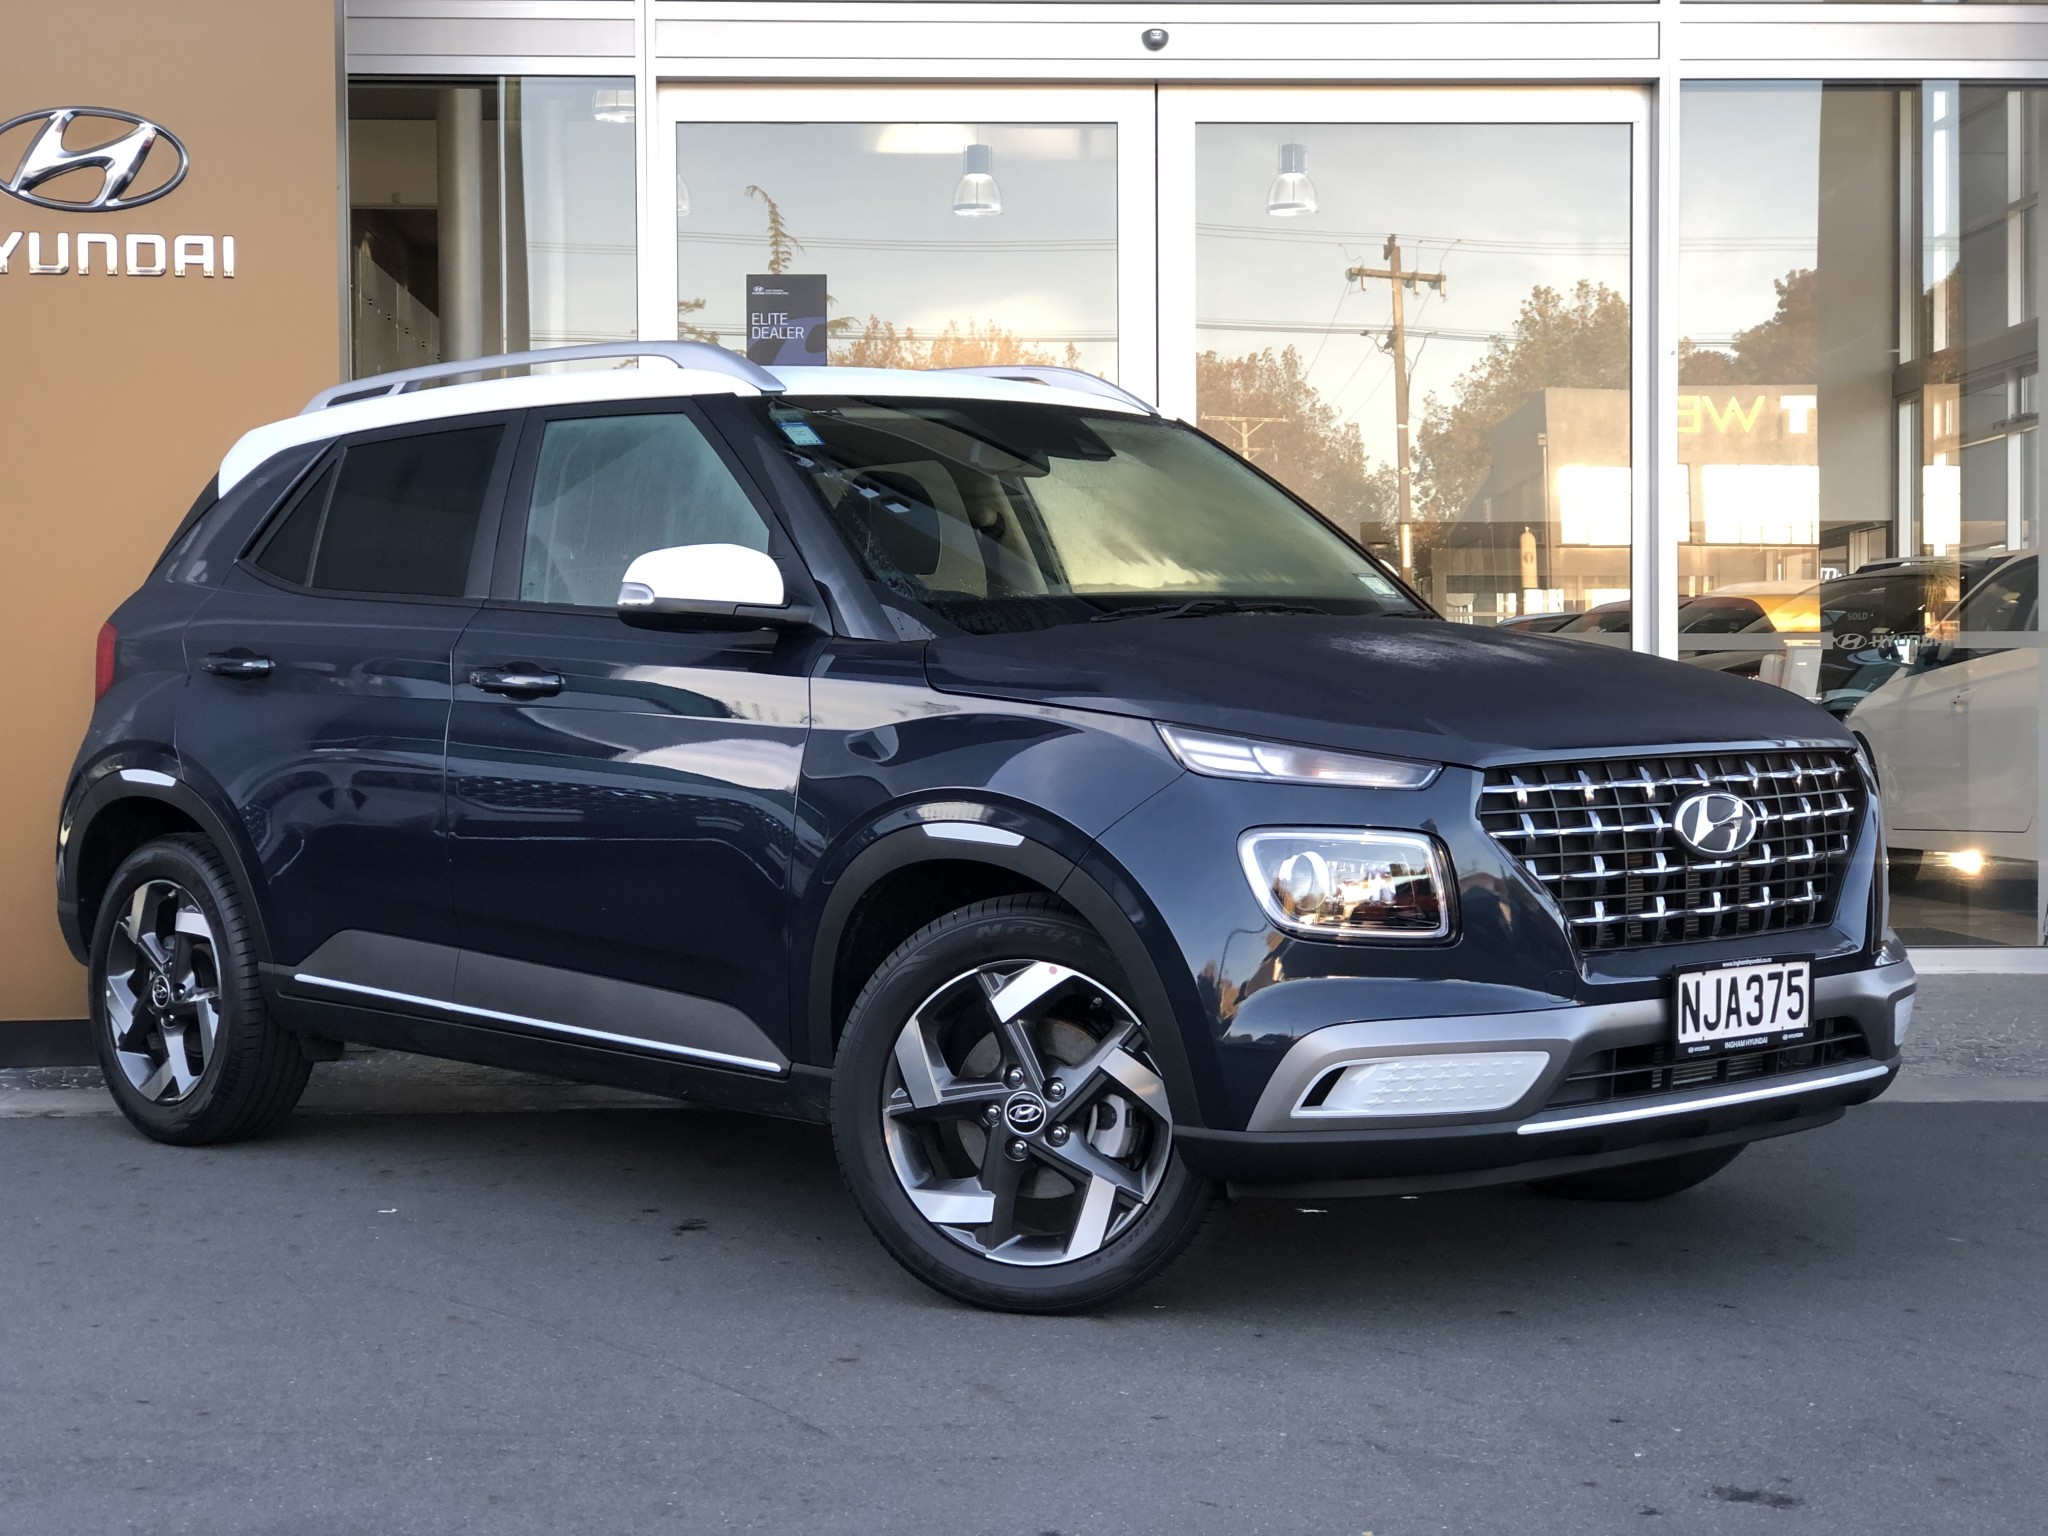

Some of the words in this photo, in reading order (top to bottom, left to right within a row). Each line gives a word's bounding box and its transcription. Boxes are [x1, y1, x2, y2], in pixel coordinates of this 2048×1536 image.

[751, 312, 789, 326] ELITE
[751, 326, 805, 340] DEALER
[1847, 611, 1869, 621] SOLD
[1681, 968, 1805, 1035] NJA375
[1724, 1039, 1746, 1050] INGHAM
[1745, 1036, 1768, 1047] HYUNDAI
